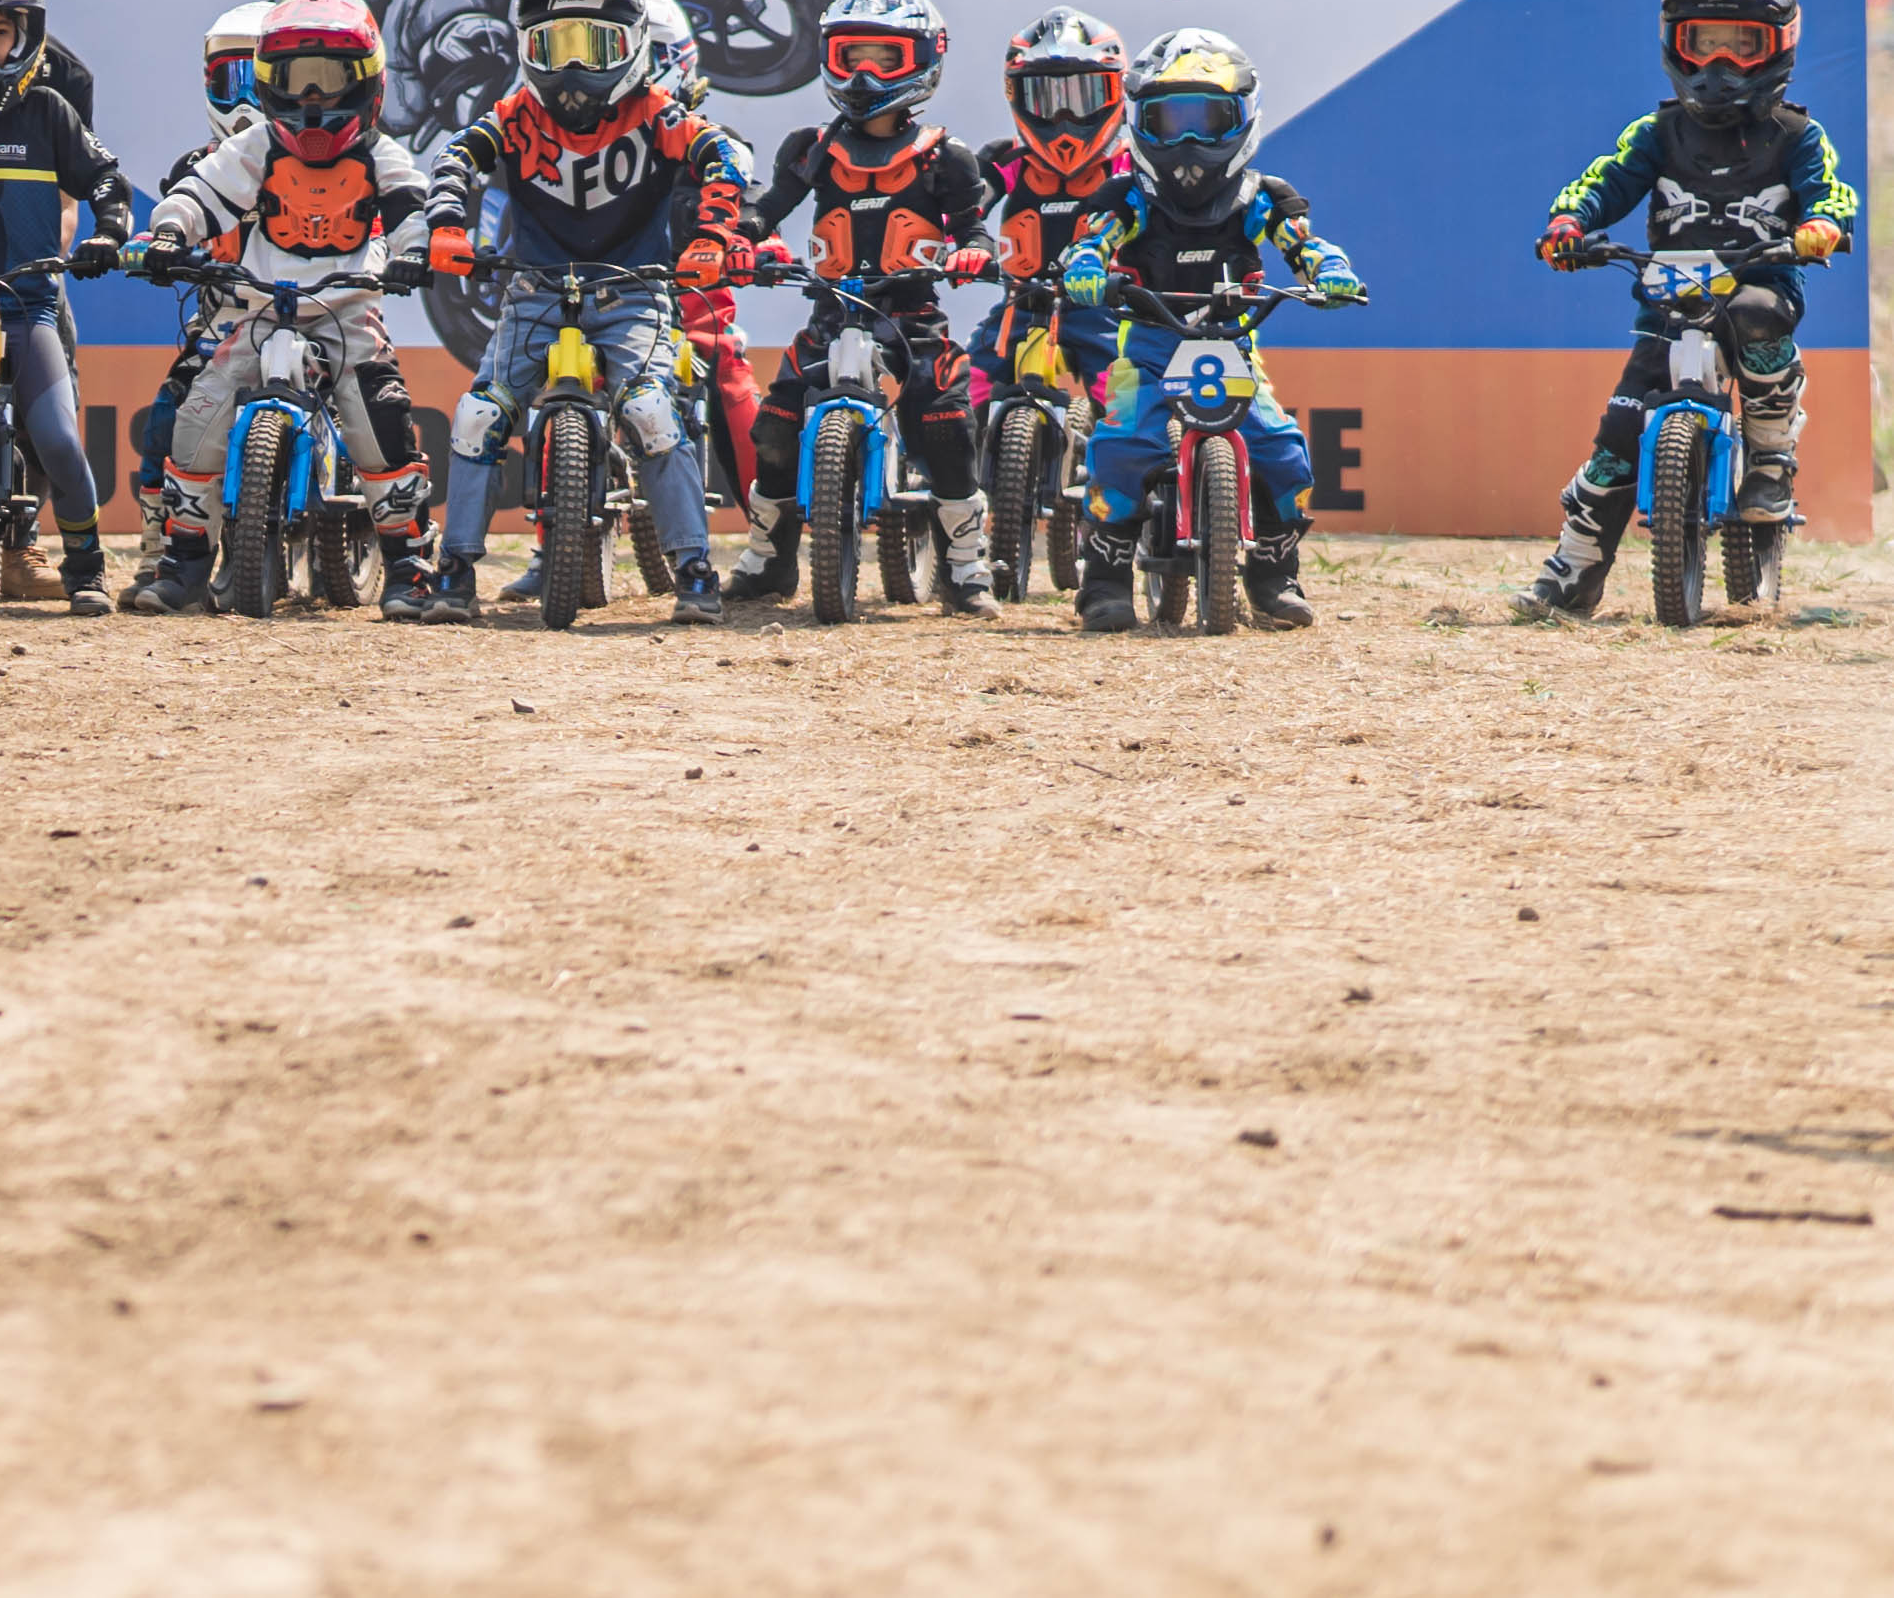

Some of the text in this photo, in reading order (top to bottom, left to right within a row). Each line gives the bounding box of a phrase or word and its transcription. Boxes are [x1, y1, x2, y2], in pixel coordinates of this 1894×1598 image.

[850, 195, 892, 211] LEATT
[148, 240, 180, 252] FOX
[1176, 249, 1216, 264] LEATT
[1191, 353, 1228, 409] 8
